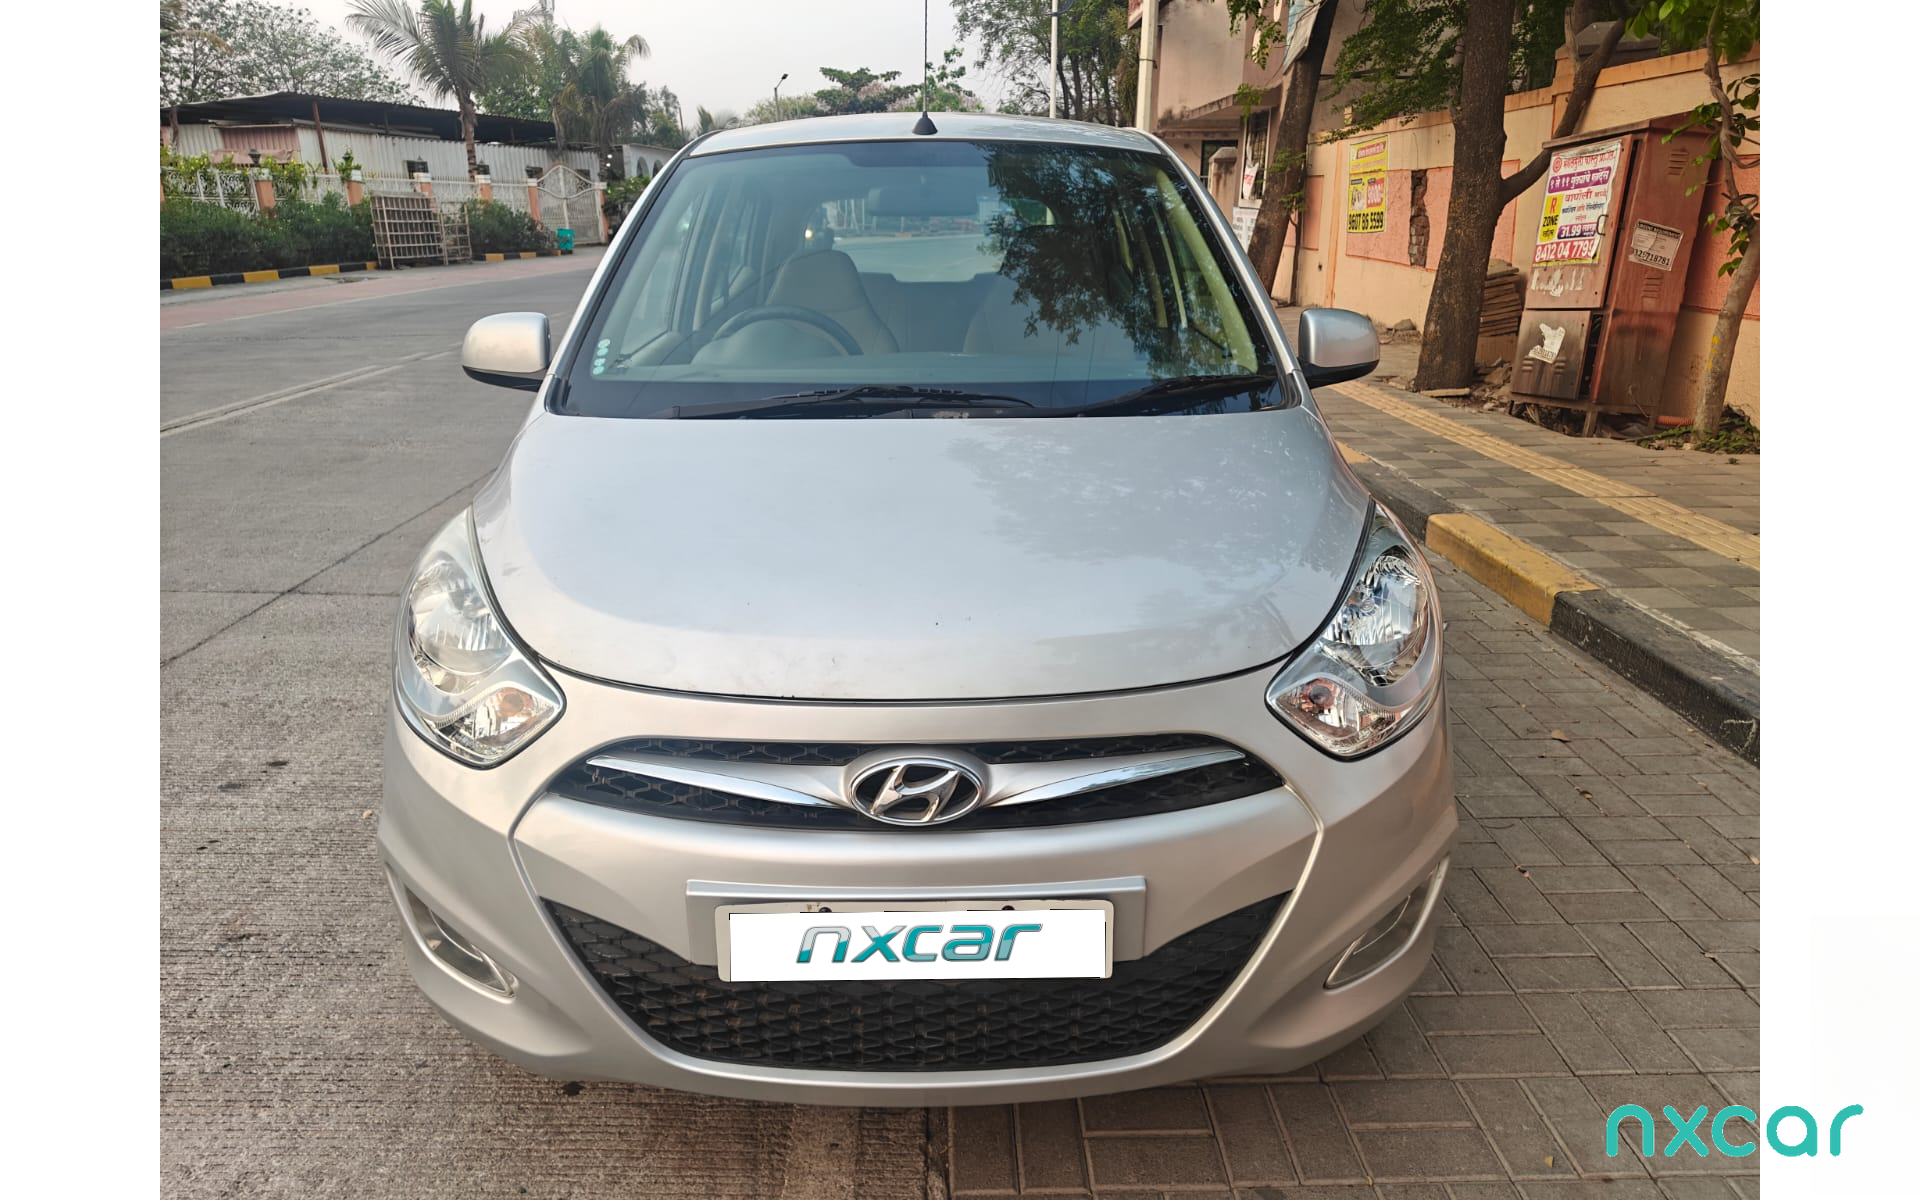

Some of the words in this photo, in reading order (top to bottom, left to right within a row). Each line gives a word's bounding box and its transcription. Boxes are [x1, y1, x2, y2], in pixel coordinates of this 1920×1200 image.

[1550, 197, 1558, 214] R
[1543, 214, 1559, 227] ZONE
[1535, 244, 1557, 263] 8412
[1557, 241, 1571, 259] 04
